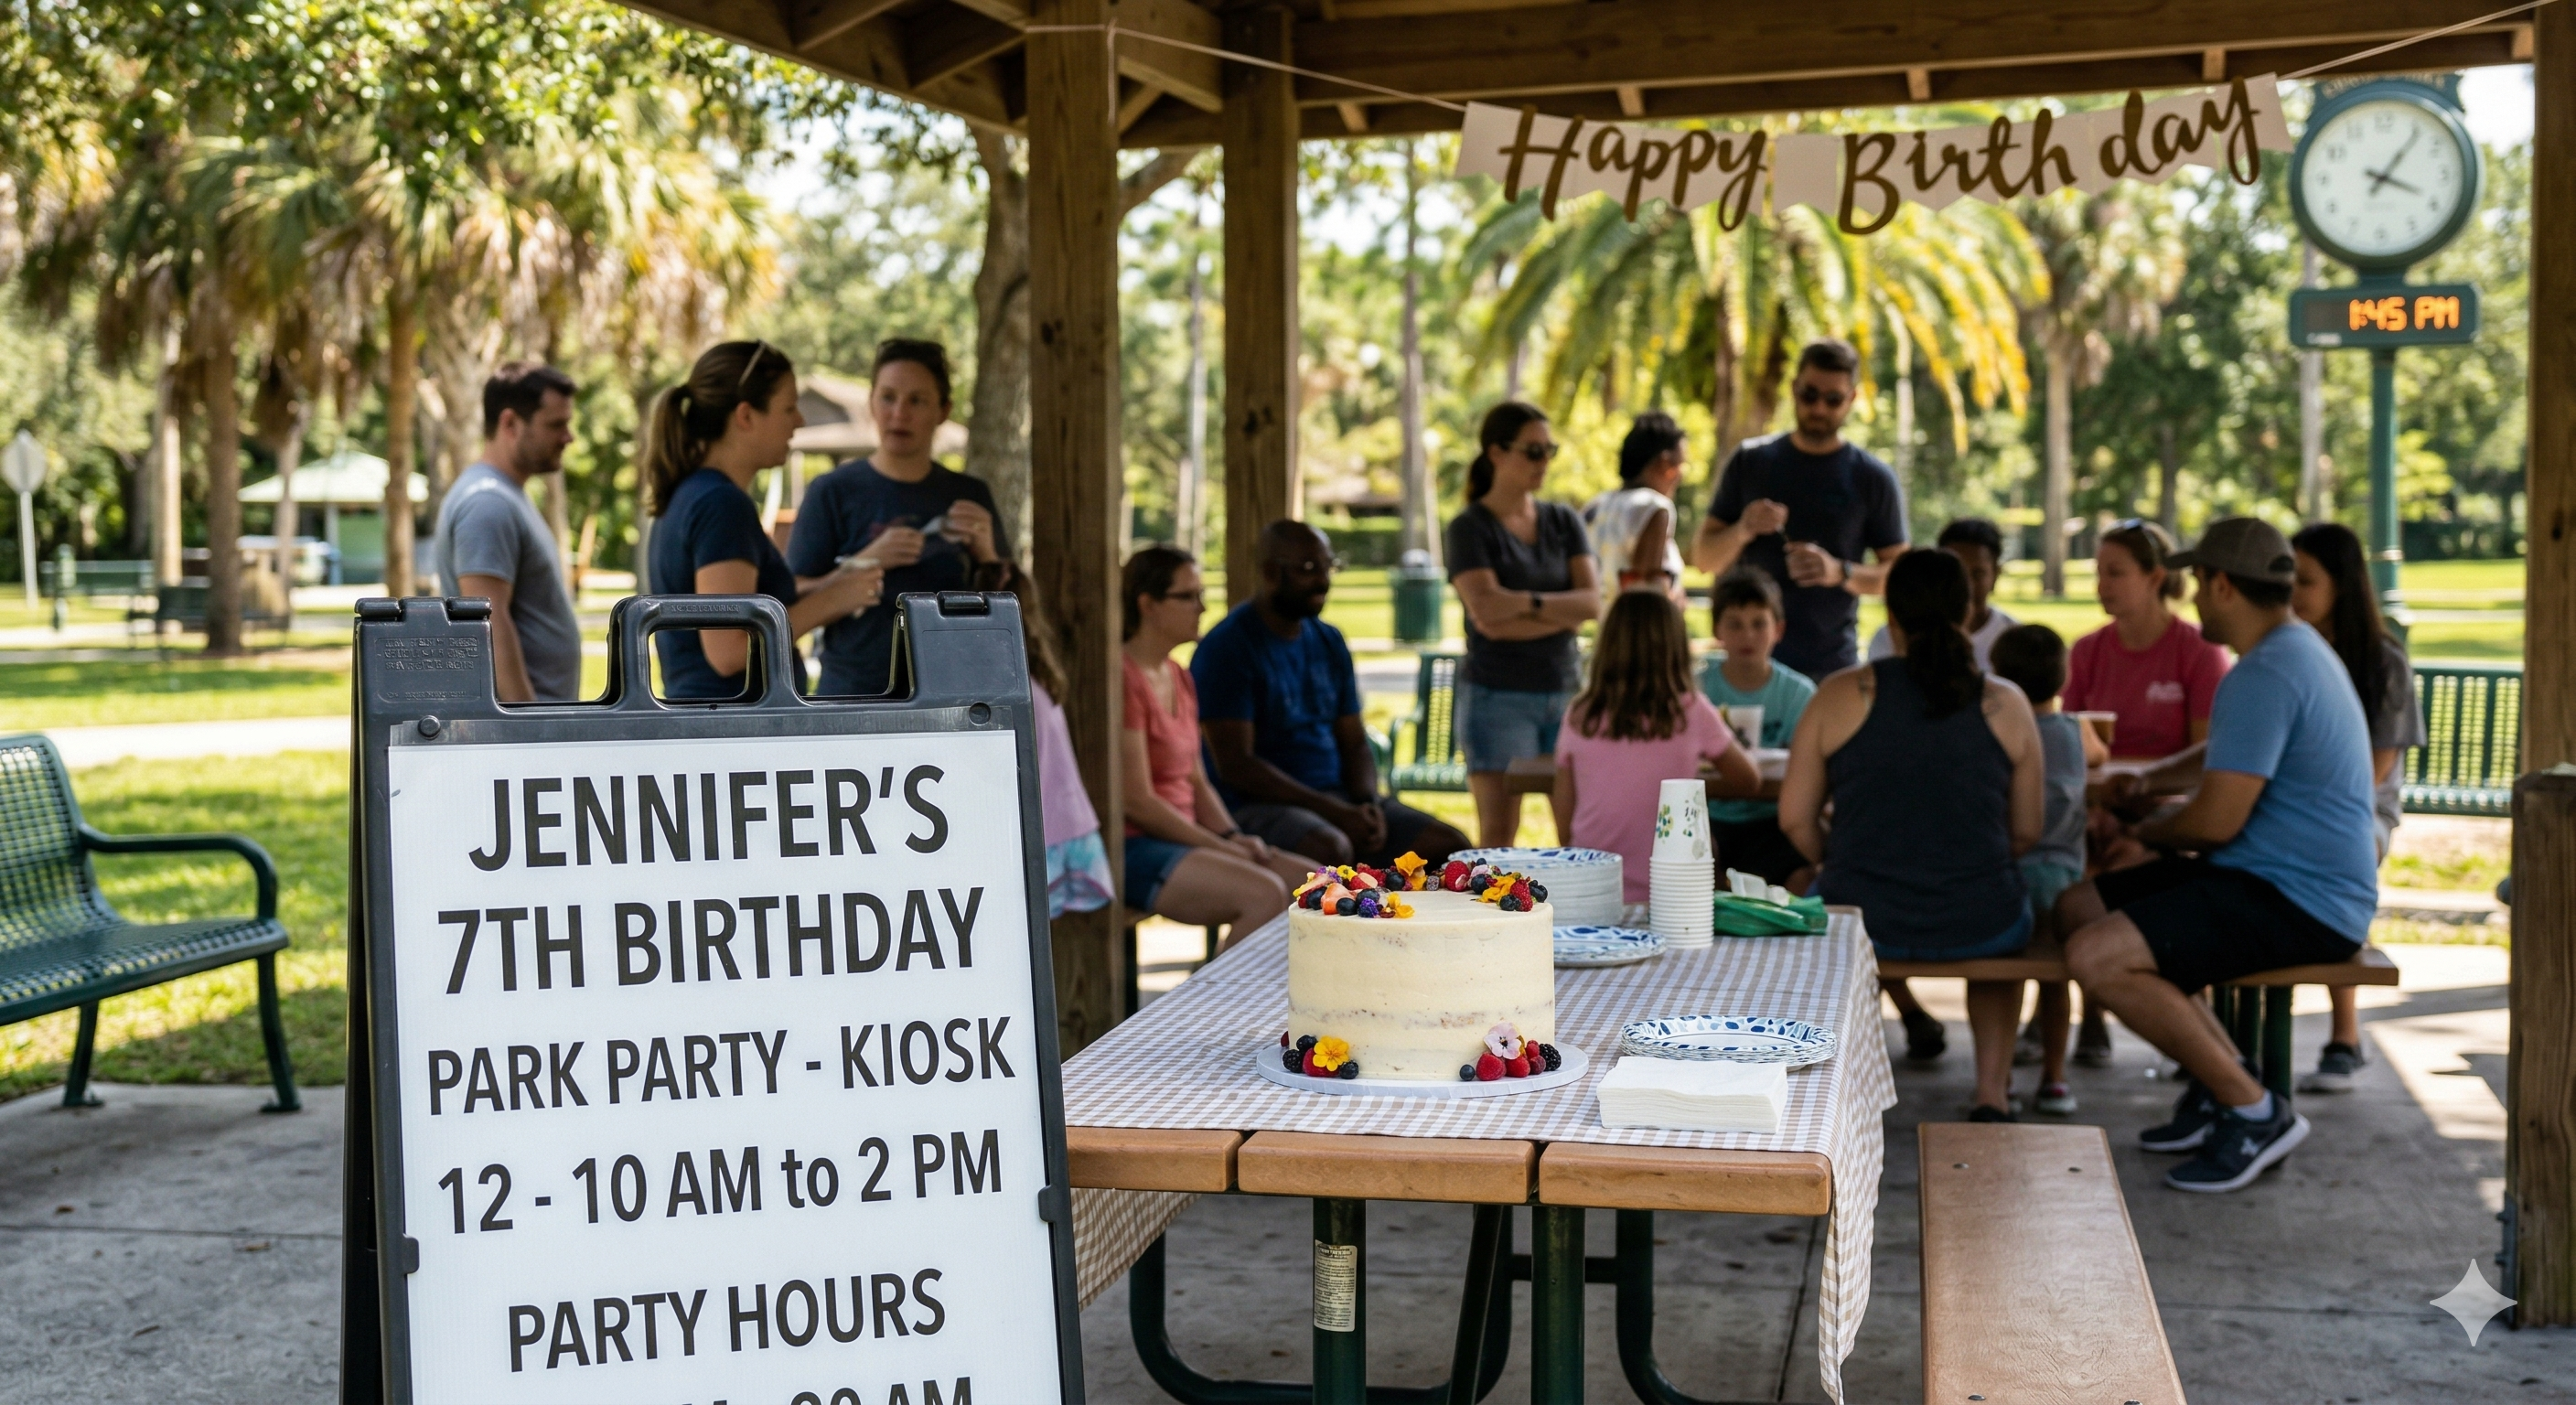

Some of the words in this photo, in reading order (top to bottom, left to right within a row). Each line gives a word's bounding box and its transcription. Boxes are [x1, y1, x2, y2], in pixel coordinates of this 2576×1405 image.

[1497, 102, 1768, 231] Happy
[2414, 295, 2460, 330] PM
[469, 765, 949, 872] JENNIFER'S
[437, 904, 586, 995] 7TH
[615, 886, 985, 986] BIRTHDAY
[427, 1040, 590, 1116] PARK
[606, 1029, 789, 1105] PARTY
[805, 1060, 821, 1071] -
[840, 1015, 1017, 1089] KIOSK
[437, 1164, 514, 1235] 12
[533, 1196, 553, 1208] -
[571, 1153, 648, 1224] 10
[666, 1145, 763, 1218] AM
[780, 1149, 840, 1209] to
[857, 1136, 892, 1203] 2
[912, 1129, 1003, 1199] PM
[509, 1289, 708, 1374] PARTY
[727, 1268, 947, 1353] HOURS
